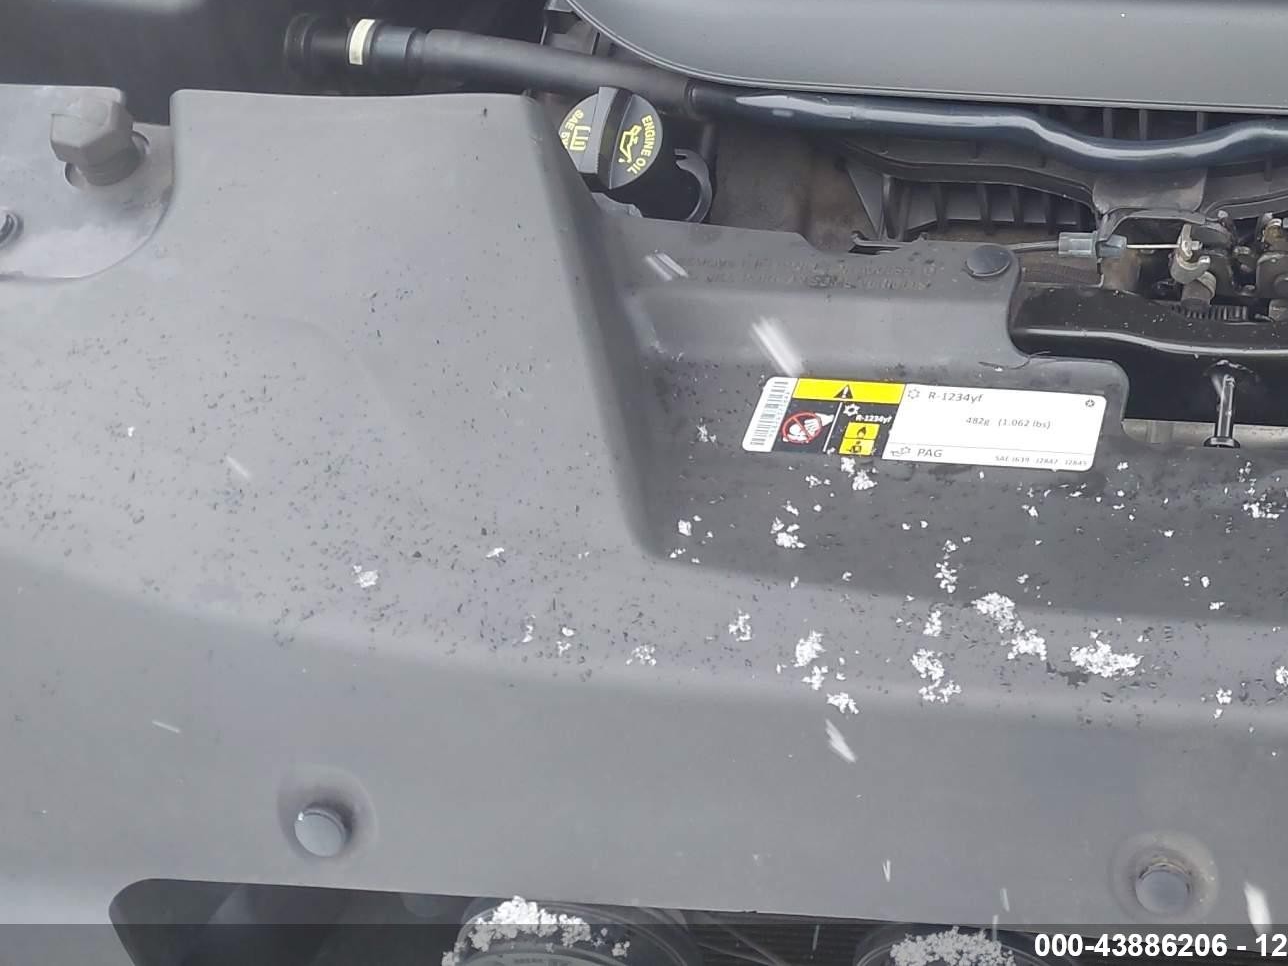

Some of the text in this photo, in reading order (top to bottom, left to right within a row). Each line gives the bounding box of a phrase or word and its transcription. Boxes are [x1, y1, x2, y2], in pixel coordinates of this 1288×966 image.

[565, 110, 584, 131] SAE
[627, 115, 656, 174] ENGINE OIL
[928, 392, 983, 403] R-1234yf
[855, 414, 893, 424] R-1234yf
[965, 417, 1051, 429] 482g (1.062 lbs)
[917, 448, 943, 458] PAG
